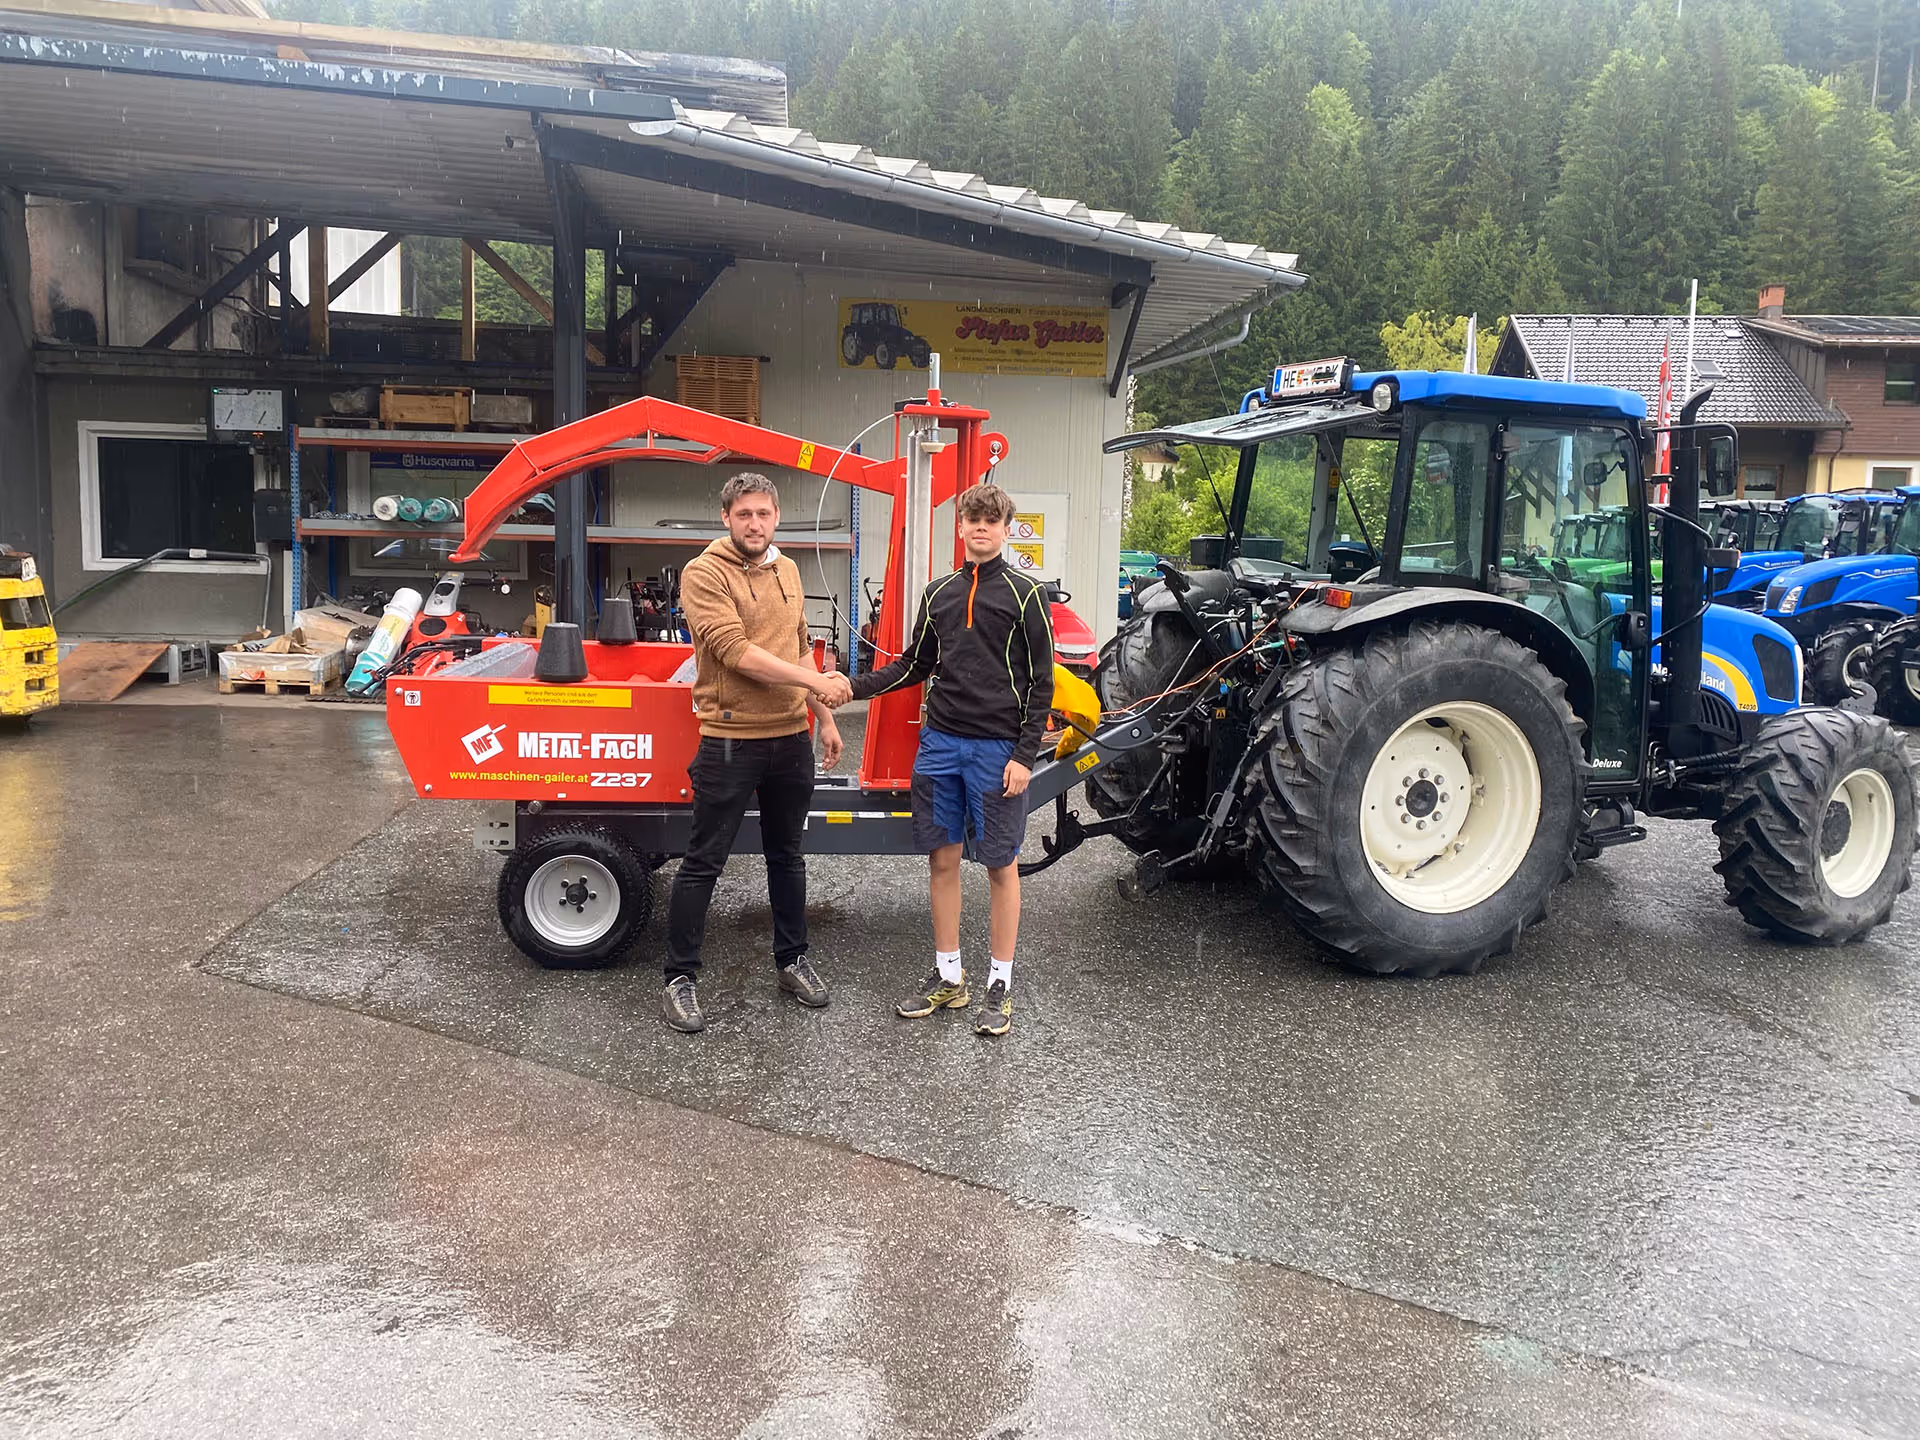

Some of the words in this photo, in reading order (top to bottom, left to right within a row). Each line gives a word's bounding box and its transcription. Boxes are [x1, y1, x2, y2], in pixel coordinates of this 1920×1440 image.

[415, 456, 475, 468] Husqvarna
[1739, 703, 1757, 711] T4030
[470, 732, 493, 756] MF
[1593, 758, 1622, 768] Deluxe
[449, 770, 589, 784] www.maschinen-gailer.at
[590, 772, 652, 788] Z237
